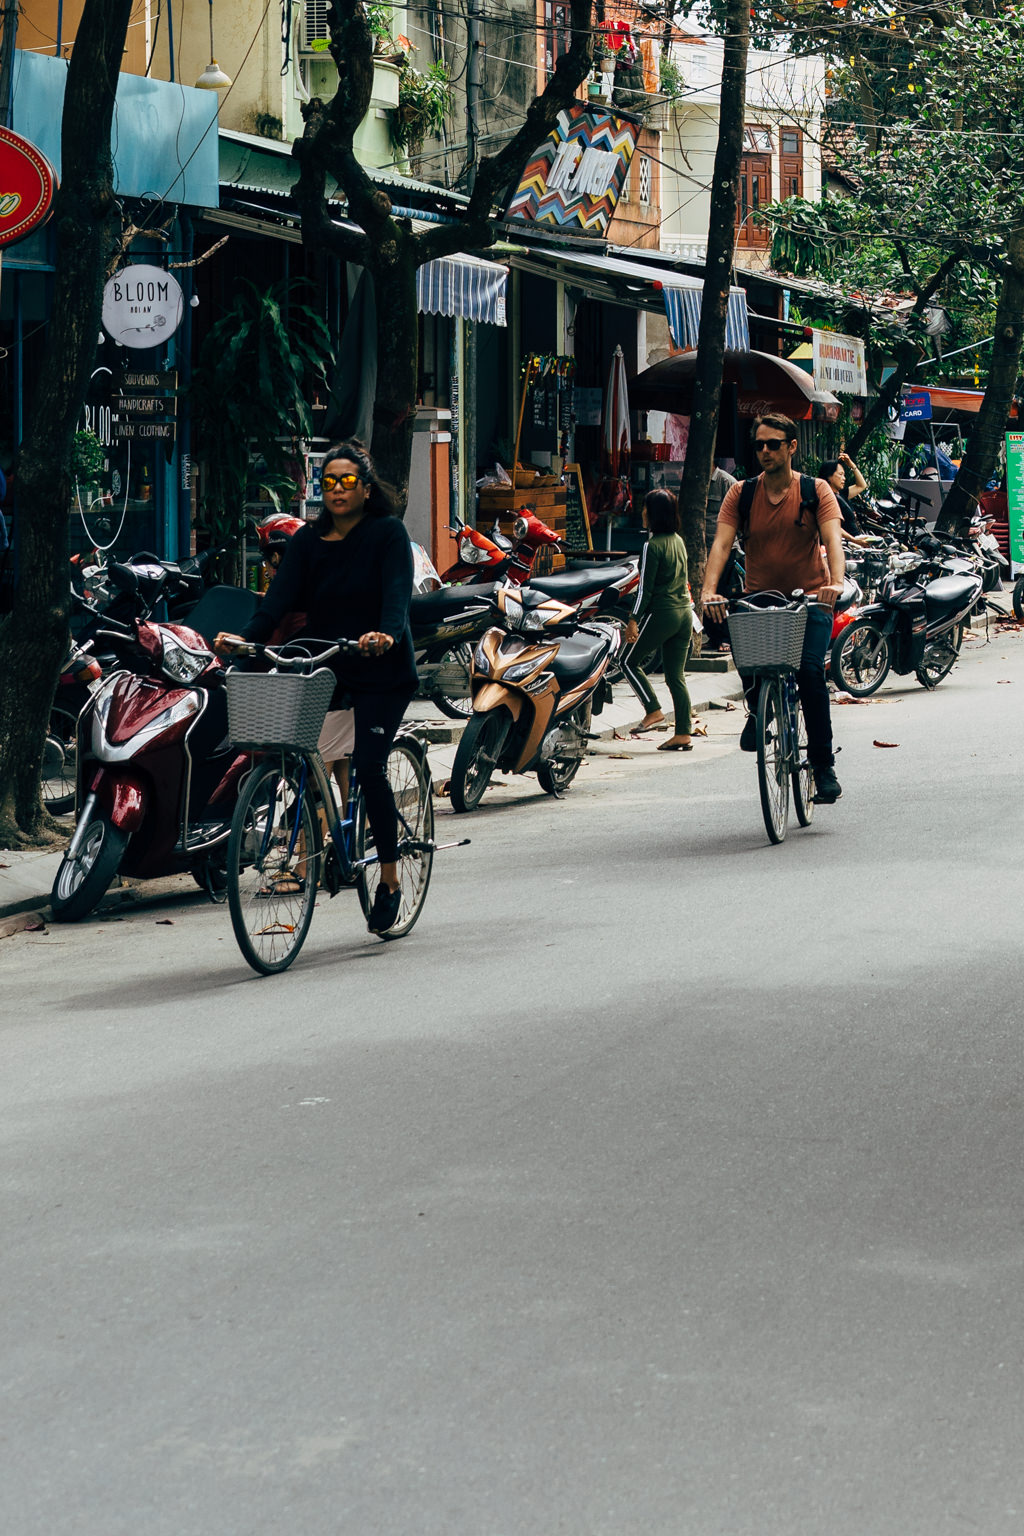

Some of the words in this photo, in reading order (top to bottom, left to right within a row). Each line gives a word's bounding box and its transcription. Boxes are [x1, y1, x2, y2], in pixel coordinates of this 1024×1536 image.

[114, 282, 169, 302] BLOOM
[124, 374, 160, 385] SOUVENIRS
[119, 399, 164, 411] HANDICRAFTS
[904, 409, 922, 417] CARD
[115, 425, 135, 436] LINEN
[139, 425, 170, 437] CLOTHING
